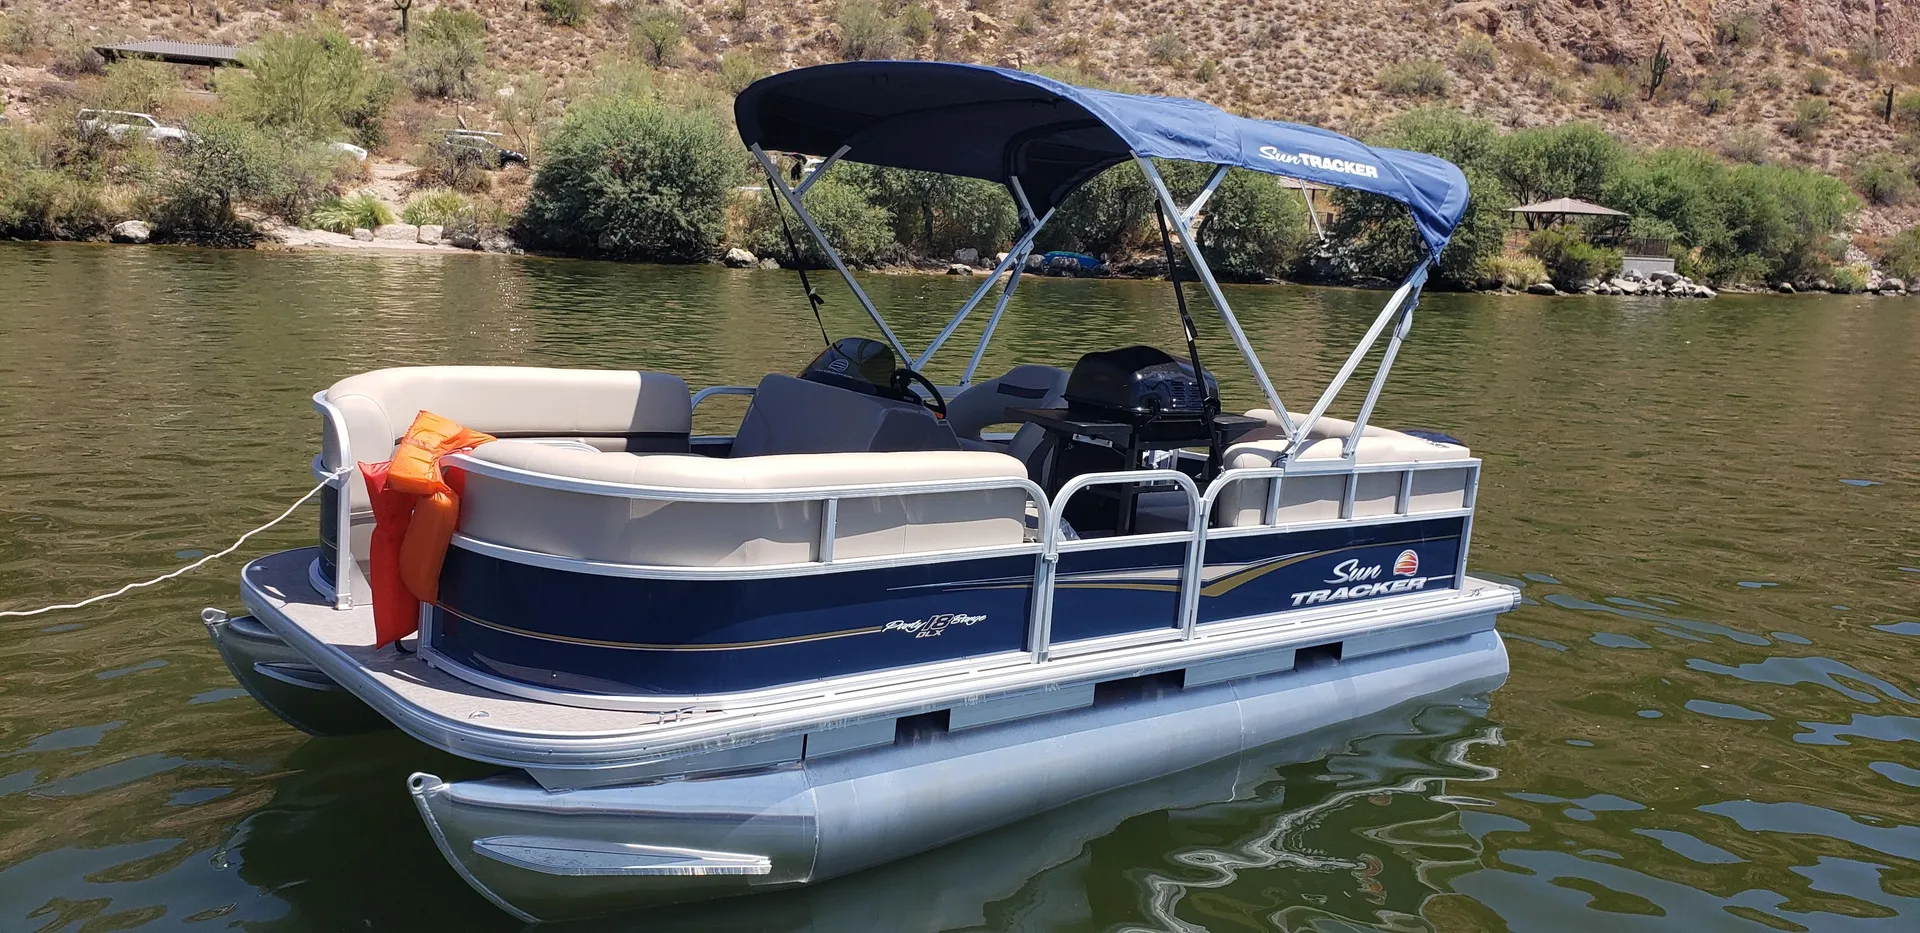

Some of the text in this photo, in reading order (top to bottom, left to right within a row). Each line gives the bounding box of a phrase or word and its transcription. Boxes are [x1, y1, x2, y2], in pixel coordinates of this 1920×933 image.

[1323, 558, 1382, 584] Sun
[1291, 577, 1427, 606] TRACKER
[882, 619, 926, 633] Party
[921, 614, 954, 631] 18
[915, 629, 944, 639] DLX
